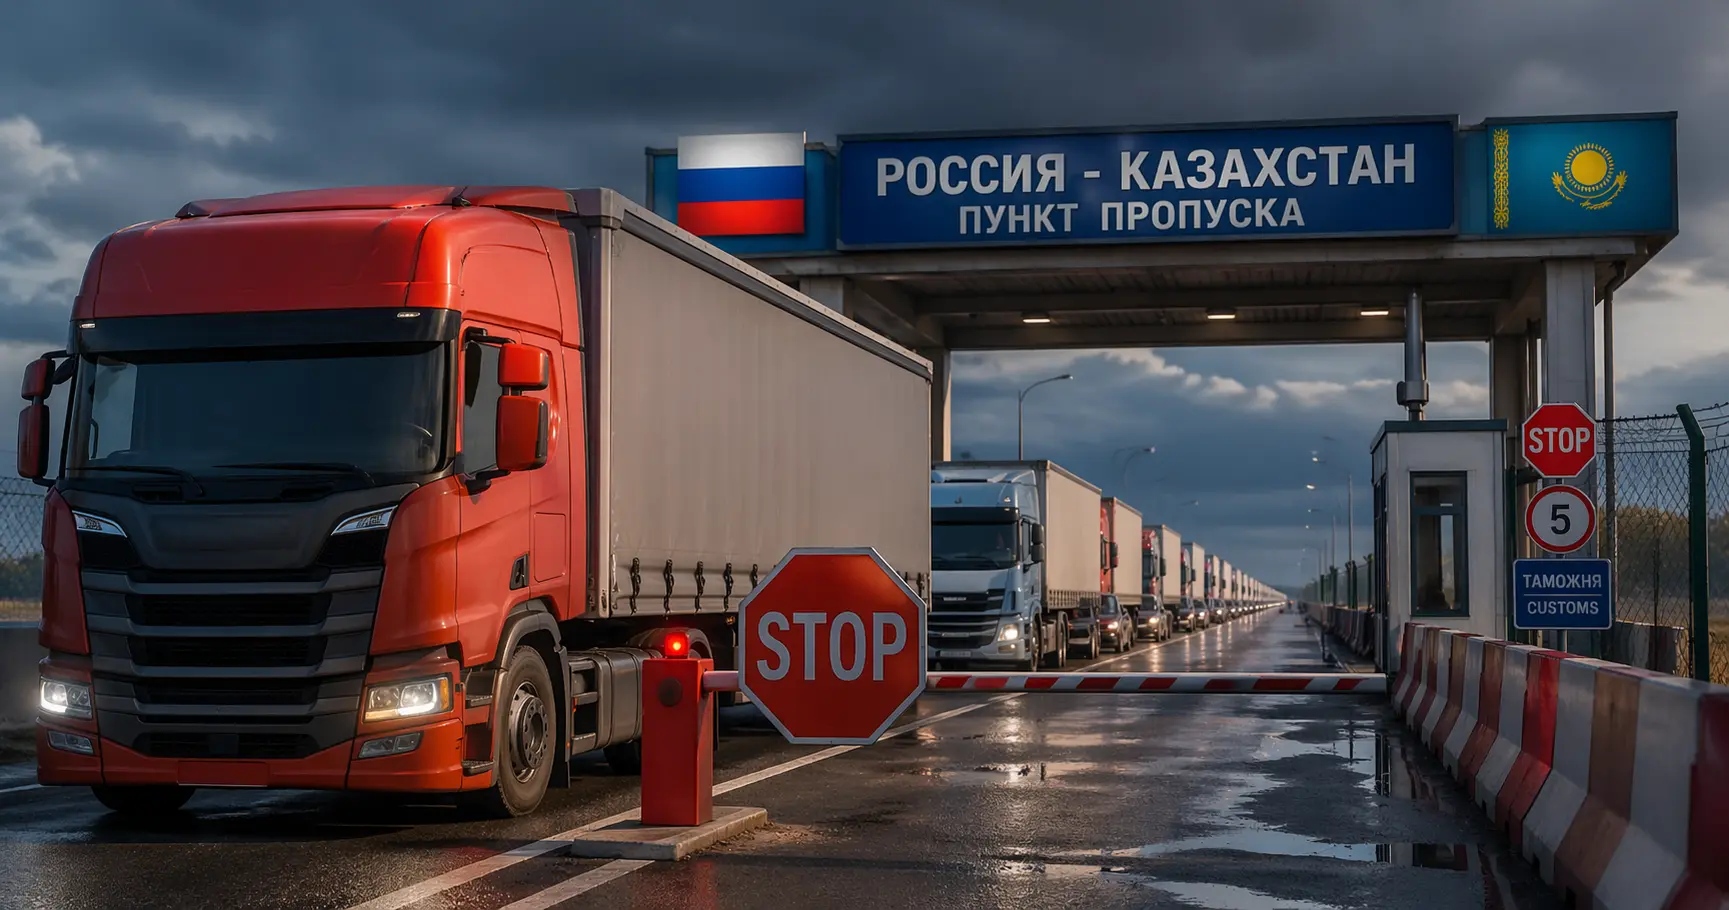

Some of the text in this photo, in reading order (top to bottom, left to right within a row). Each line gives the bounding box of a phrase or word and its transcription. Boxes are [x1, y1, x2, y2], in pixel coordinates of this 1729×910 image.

[877, 153, 1066, 197] РОССИЯ
[1121, 143, 1416, 190] КАЗАХСТАН
[959, 198, 1305, 236] ПУНКТ ПРОПУСКА
[1528, 427, 1591, 453] STOP
[1550, 504, 1571, 535] 5
[1523, 574, 1602, 589] ТАМОЖНЯ
[1527, 601, 1599, 615] CUSTOMS
[757, 611, 907, 681] STOP
